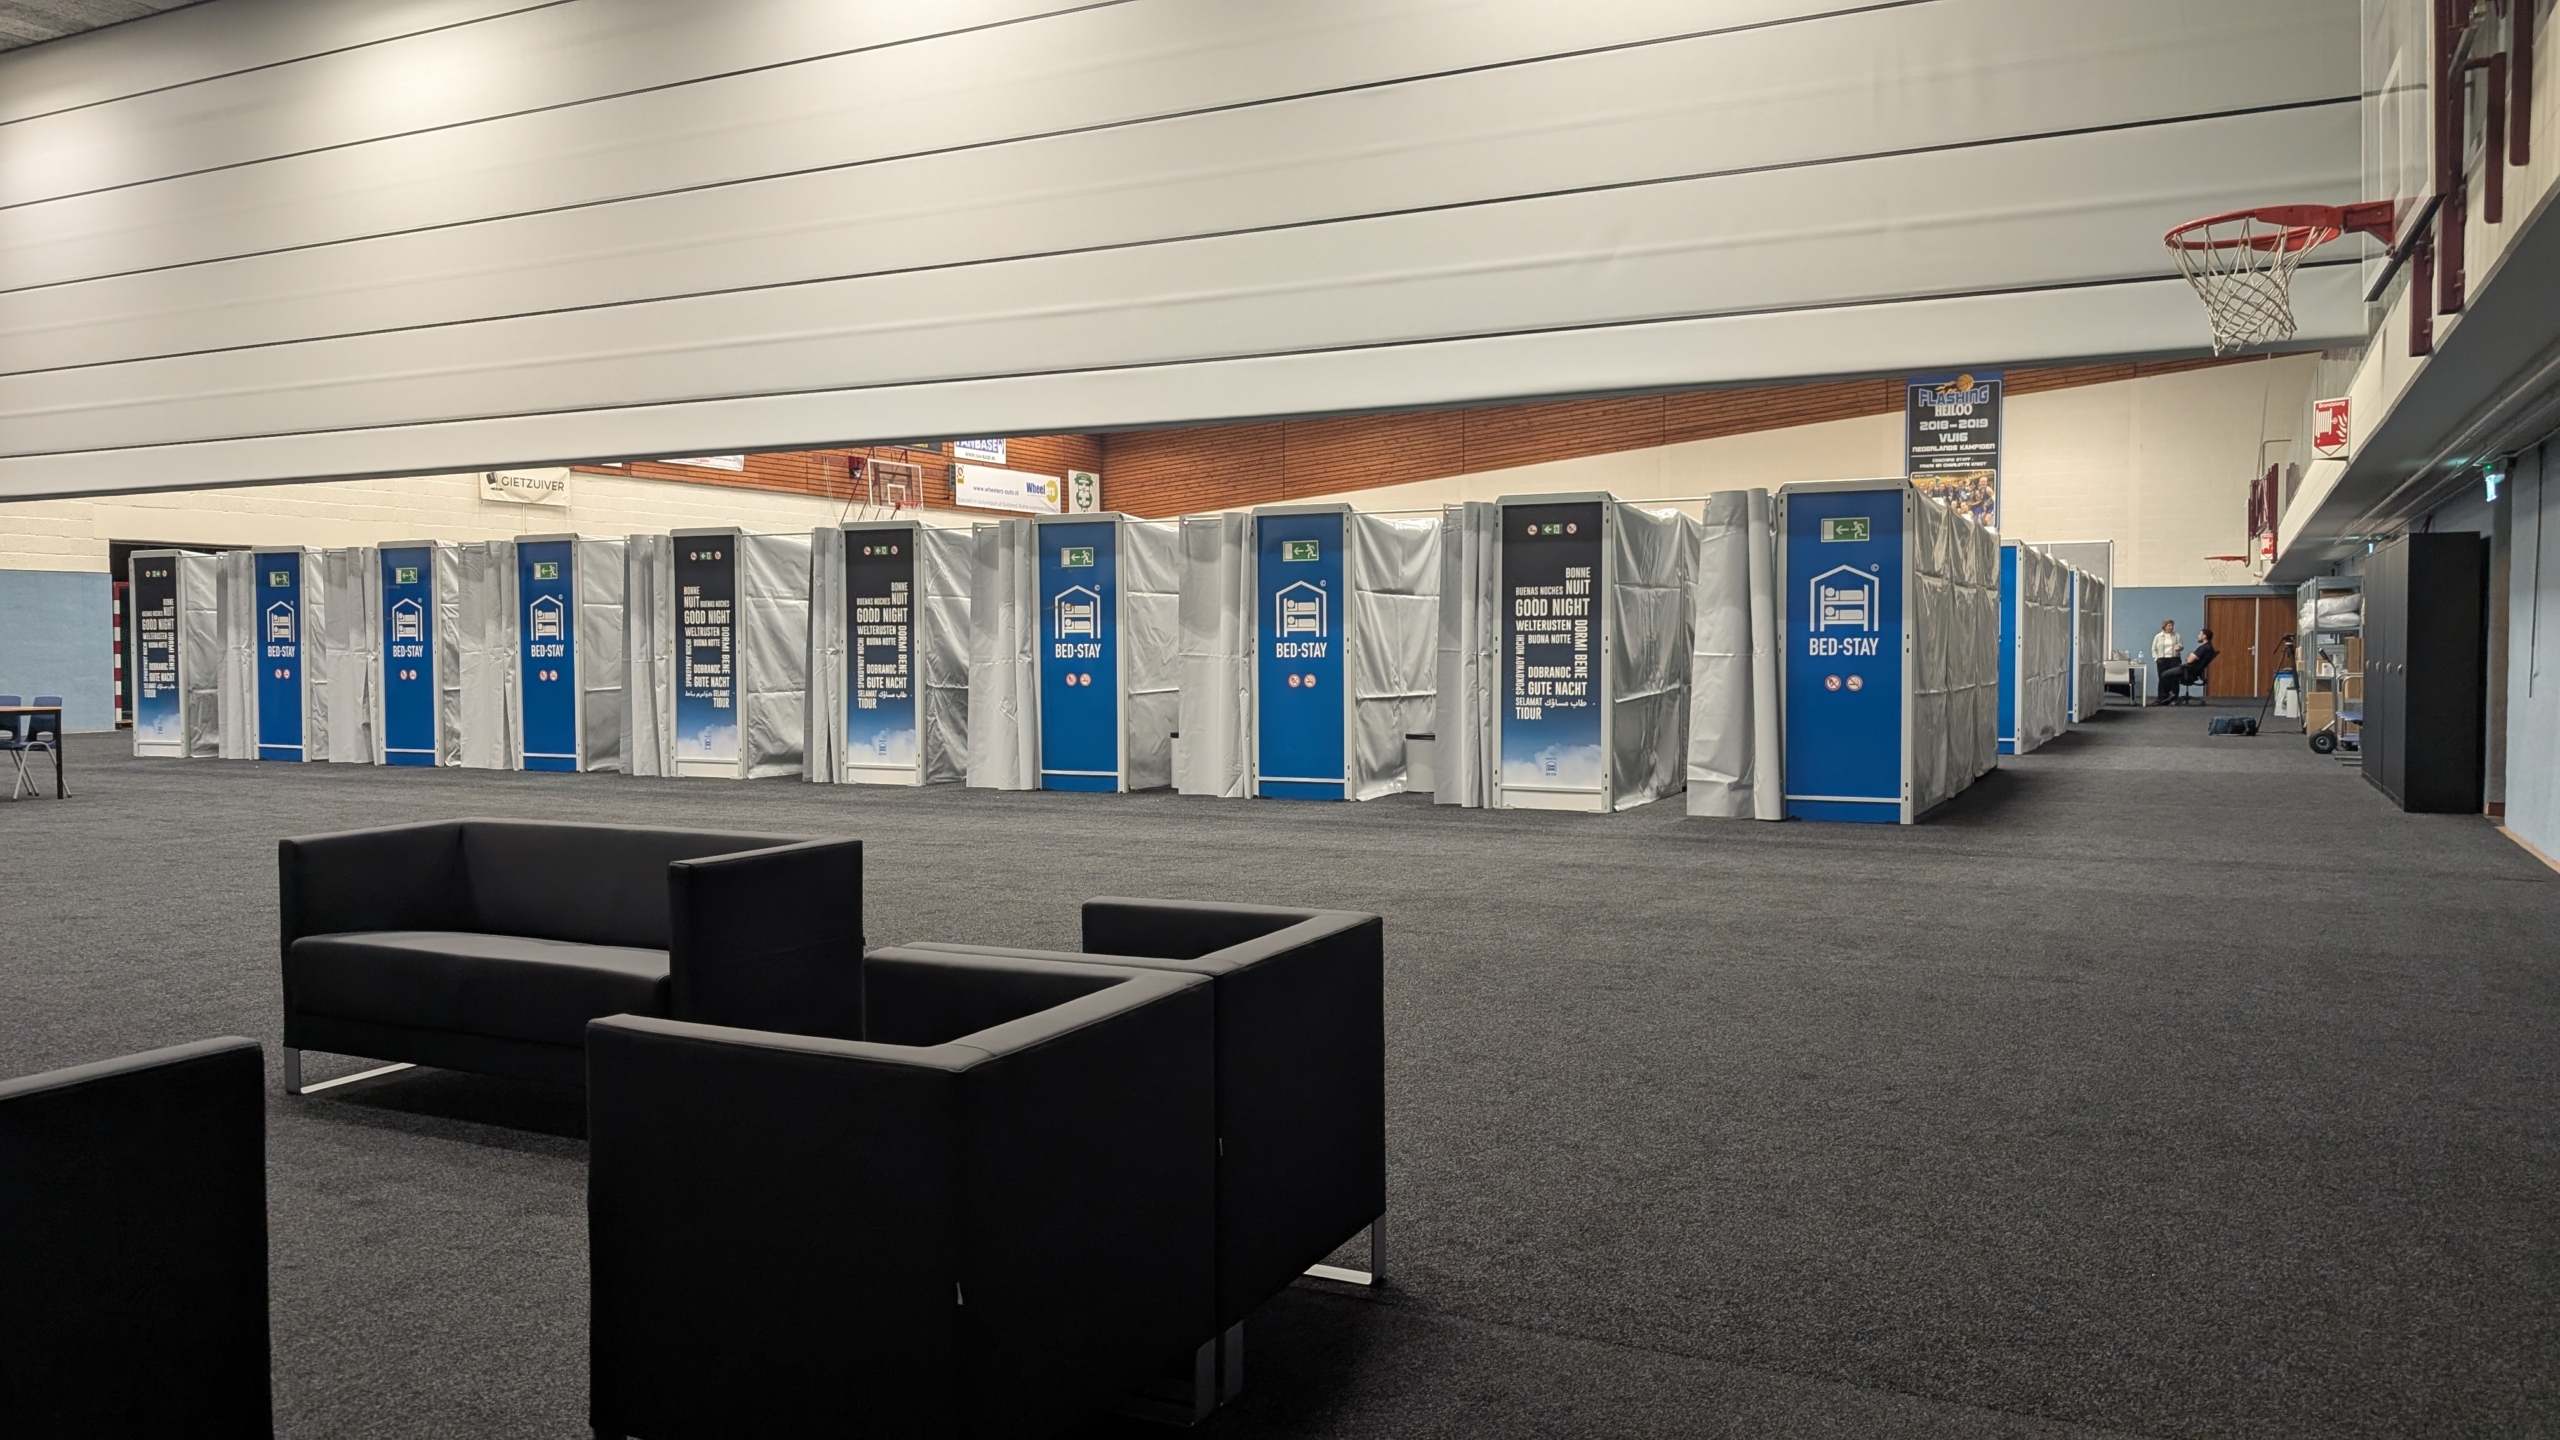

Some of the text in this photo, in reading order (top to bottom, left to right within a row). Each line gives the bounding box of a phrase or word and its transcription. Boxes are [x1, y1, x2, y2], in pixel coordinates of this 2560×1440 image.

[1919, 384, 1989, 407] FLASHING
[1935, 404, 1973, 416] HEILOO
[501, 476, 564, 491] GIETZUIVER
[1565, 567, 1591, 578] BONNE
[684, 586, 700, 595] BONNE
[891, 582, 908, 591] BONNE
[1516, 586, 1563, 596] BUENAS NOCHES
[1565, 580, 1591, 595] NUIT
[684, 596, 700, 608] NUIT
[891, 592, 908, 605] NUIT
[1516, 598, 1590, 617] GOOD NIGHT
[684, 610, 730, 624] GOOD NIGHT
[857, 608, 908, 622] GOOD NIGHT
[857, 625, 896, 635] WELTERUSTEN
[1516, 620, 1572, 631] WELTERUSTEN
[866, 637, 896, 645] BUONA NOTTE
[1528, 634, 1572, 644] BUONA NOTTE
[267, 646, 295, 657] BED-STAY
[393, 646, 424, 657] BED-STAY
[531, 645, 564, 657] BED-STAY
[722, 627, 730, 674] DORMI BENE
[898, 626, 907, 674] DORMI BENE
[1055, 644, 1101, 658] BED-STAY
[1276, 642, 1327, 658] BED-STAY
[1574, 620, 1588, 679] DORMI BENE
[1809, 638, 1879, 656] BED-STAY
[694, 664, 720, 674] DOBRANOC
[867, 664, 897, 674] DOBRANOC
[1516, 635, 1525, 695] SPOKOYNOY NOCHI
[1528, 666, 1572, 678] DOBRANOC
[694, 676, 730, 687] GUTE NACHT
[867, 677, 907, 688] GUTE NACHT
[1528, 682, 1588, 696] GUTE NACHT
[713, 698, 730, 708] TIDUR
[858, 698, 877, 709] TIDUR
[1515, 697, 1543, 706] SELAMAT
[1515, 707, 1542, 720] TIDUR
